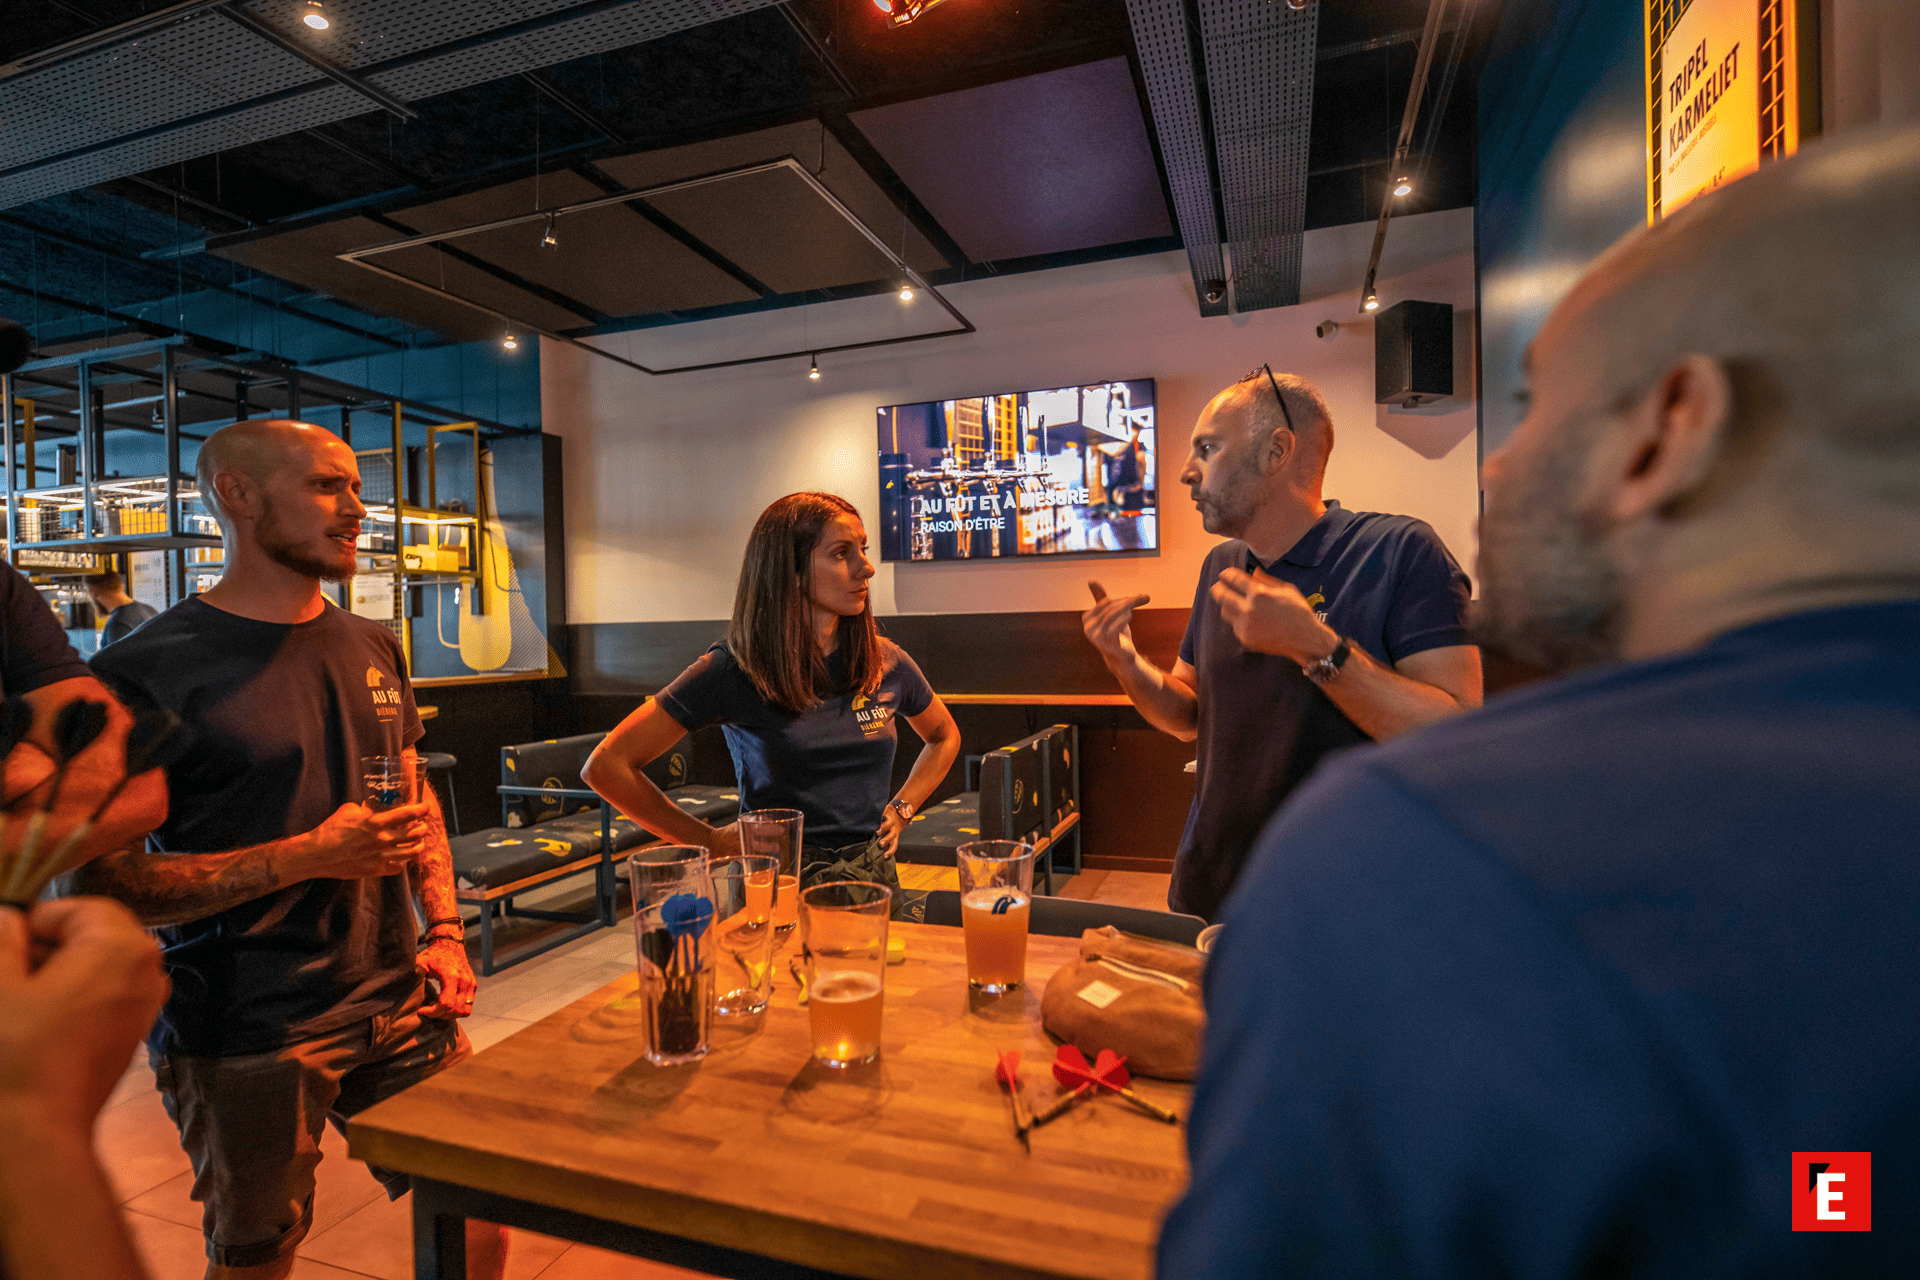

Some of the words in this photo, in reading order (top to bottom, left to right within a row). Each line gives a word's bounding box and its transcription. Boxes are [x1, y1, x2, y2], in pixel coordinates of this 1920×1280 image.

[1669, 37, 1708, 114] TRIPEL
[1669, 41, 1740, 158] KARMELIET
[920, 499, 942, 514] AU
[945, 494, 976, 512] FÛT
[979, 495, 1001, 511] ET
[1003, 490, 1017, 509] À
[1019, 488, 1090, 508] MESURE
[920, 519, 963, 534] RAISON
[965, 516, 1006, 532] D'ÊTRE
[372, 690, 387, 704] AU
[387, 687, 401, 704] FÛT
[856, 710, 871, 723] AU
[871, 705, 888, 719] FÛT
